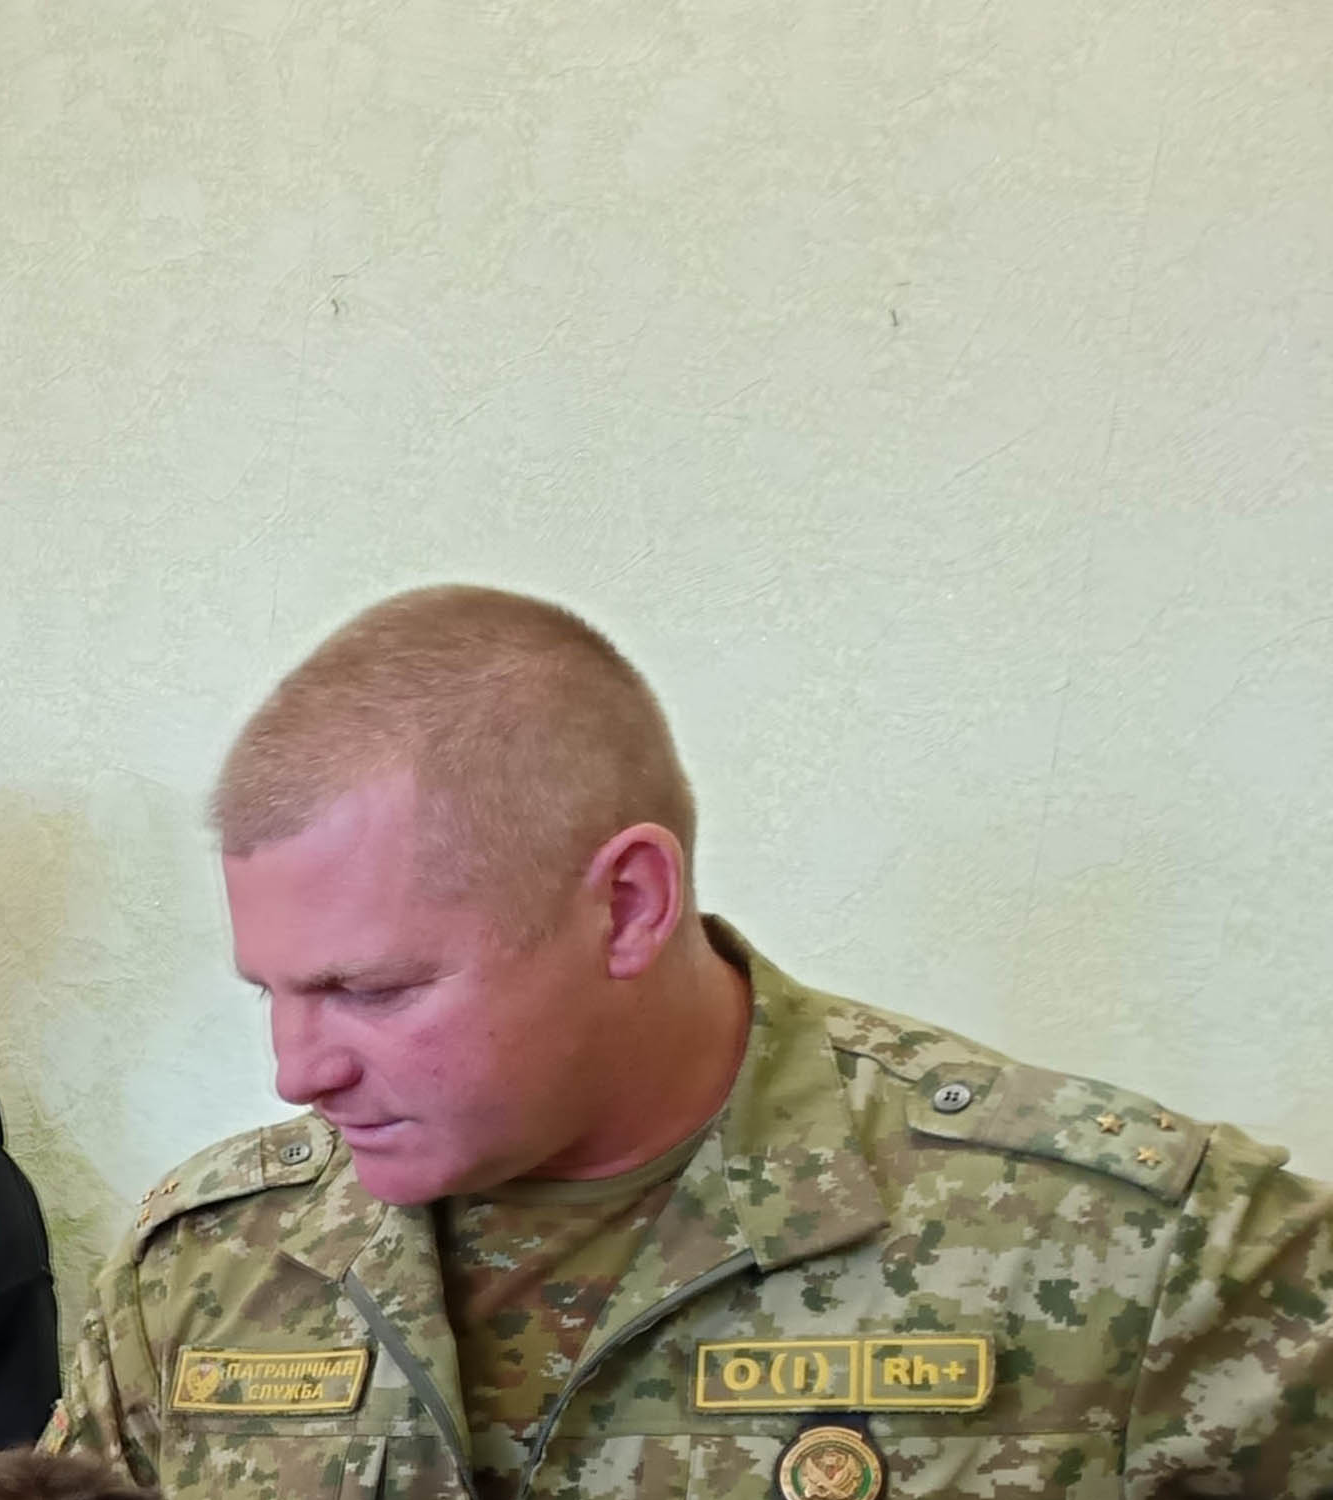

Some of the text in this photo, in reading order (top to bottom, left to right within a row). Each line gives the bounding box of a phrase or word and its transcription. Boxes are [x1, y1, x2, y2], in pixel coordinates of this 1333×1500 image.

[226, 1359, 356, 1380] ПАГРАНІЧНАЯ
[883, 1355, 967, 1386] Rh+
[247, 1382, 325, 1400] СЛУЖБА
